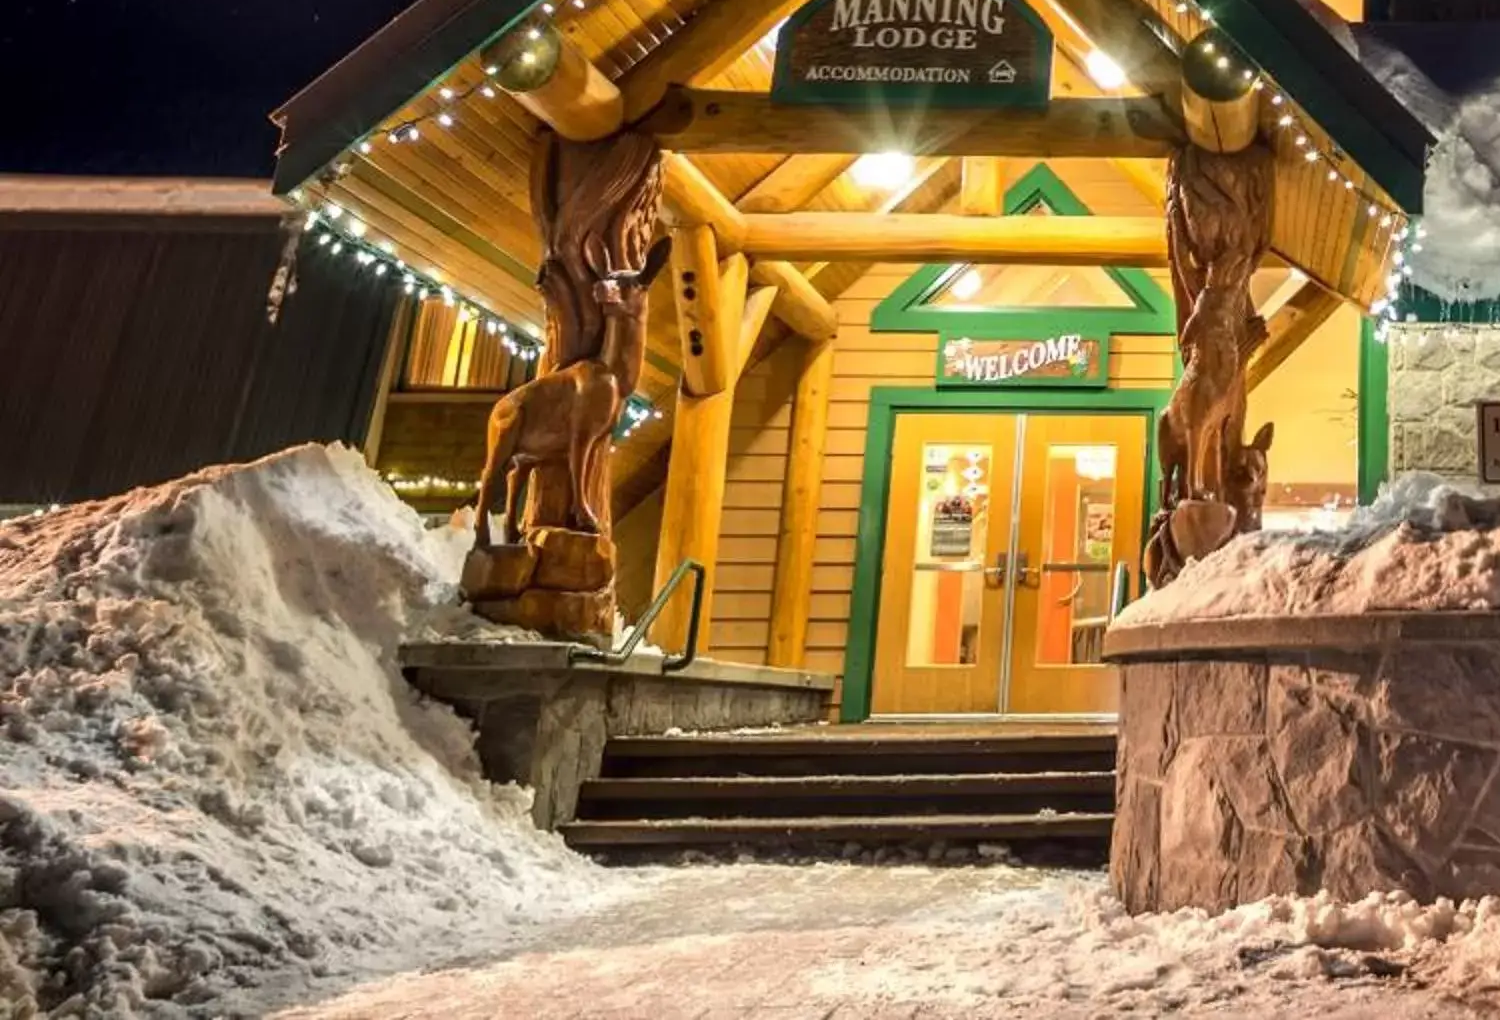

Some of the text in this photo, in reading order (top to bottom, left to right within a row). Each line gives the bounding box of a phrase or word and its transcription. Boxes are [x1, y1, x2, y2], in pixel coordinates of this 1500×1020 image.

[853, 27, 978, 49] LODGE
[806, 65, 971, 83] ACCOMMODATION
[964, 334, 1082, 381] WELCOME
